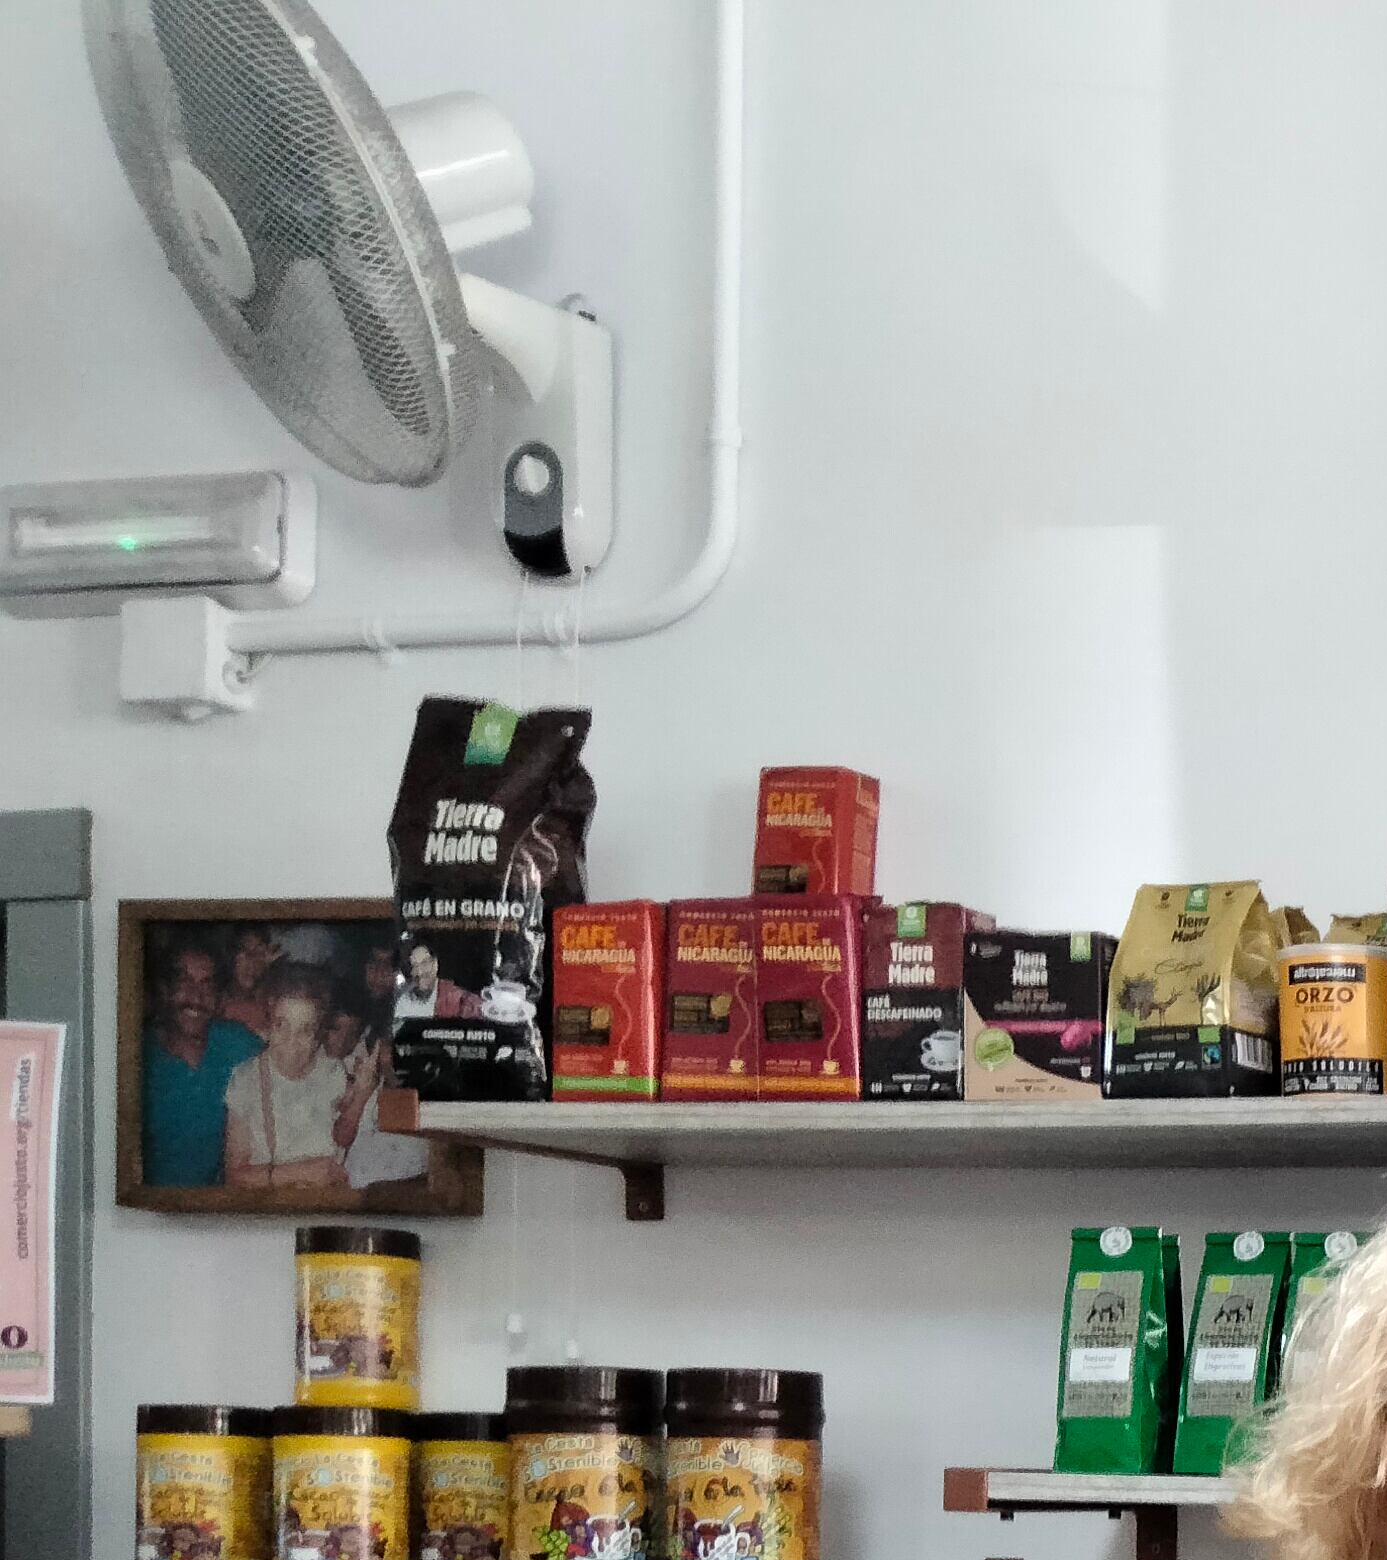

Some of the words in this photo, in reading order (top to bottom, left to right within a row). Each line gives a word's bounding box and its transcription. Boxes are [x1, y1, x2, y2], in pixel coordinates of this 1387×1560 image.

[434, 798, 505, 830] Tierra
[424, 831, 498, 865] Madre
[435, 900, 456, 917] EN
[460, 900, 525, 920] GRANO
[890, 942, 934, 962] Tierra
[888, 964, 936, 985] Madre
[1295, 987, 1355, 1005] ORZO
[867, 1007, 943, 1021] DESCAFEINADO
